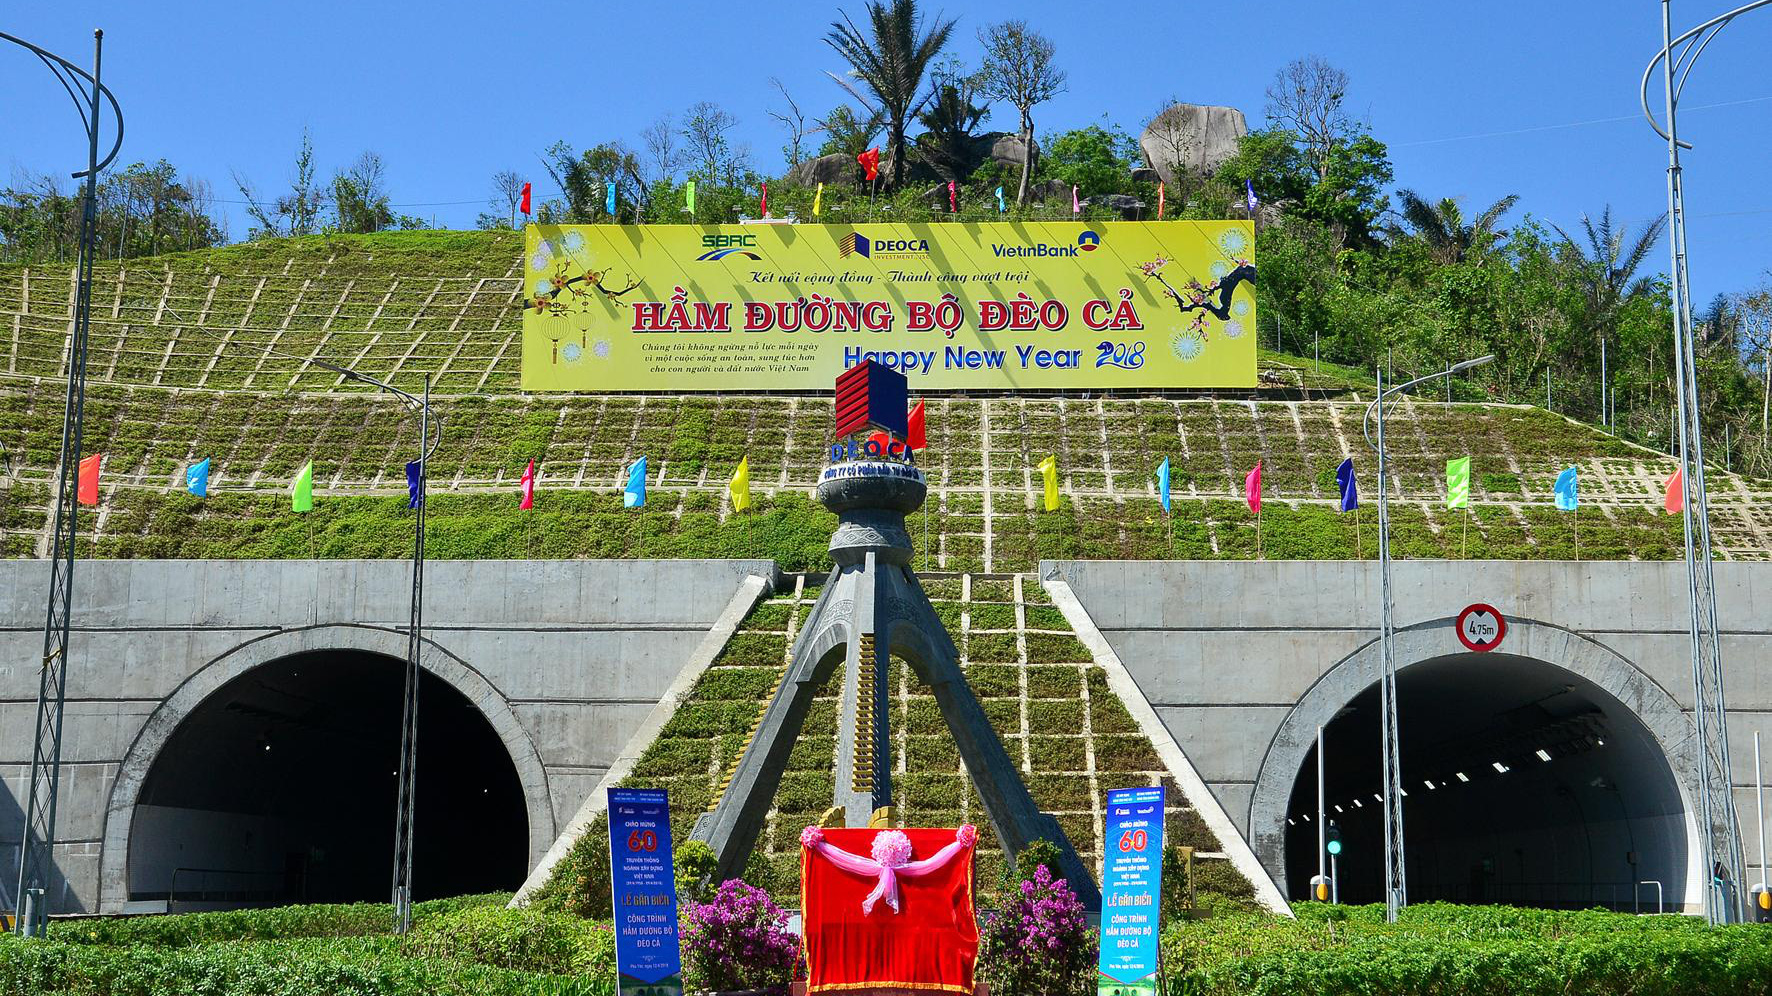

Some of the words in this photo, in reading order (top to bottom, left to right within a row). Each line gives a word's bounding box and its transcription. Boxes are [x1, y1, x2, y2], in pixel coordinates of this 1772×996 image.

[702, 234, 756, 247] SBRC
[874, 240, 930, 252] DEOCA
[991, 244, 1079, 257] VietinBank
[747, 271, 774, 283] Kết
[778, 270, 800, 283] nối
[804, 274, 834, 286] cộng
[839, 270, 874, 284] đồng
[887, 270, 932, 282] Thành
[936, 272, 967, 284] công
[972, 272, 1000, 284] vượt
[1004, 271, 1030, 284] trội
[632, 286, 731, 333] HẦM
[743, 293, 894, 333] ĐƯỜNG
[906, 292, 964, 339] BỘ
[978, 292, 1069, 332] ĐÈO
[1081, 288, 1144, 331] CẢ
[642, 344, 670, 352] Chúng
[688, 344, 715, 352] không
[718, 343, 746, 352] ngừng
[762, 343, 776, 352] lực
[798, 343, 819, 352] ngày
[656, 354, 672, 362] một
[674, 354, 694, 362] cuộc
[697, 354, 717, 362] sống
[844, 346, 937, 375] Happy
[945, 346, 1006, 370] New
[1016, 346, 1082, 370] Year
[1096, 341, 1146, 370] 2018
[686, 365, 710, 374] người
[769, 365, 786, 373] Việt
[832, 440, 914, 462] DEOCA
[1470, 620, 1494, 635] 4.75m
[628, 830, 658, 852] 60
[1119, 830, 1147, 852] 60
[628, 914, 646, 923] CÔNG
[647, 913, 667, 922] TRÌNH
[1112, 914, 1128, 923] CÔNG
[1129, 913, 1148, 923] TRÌNH
[664, 925, 672, 936] BỘ
